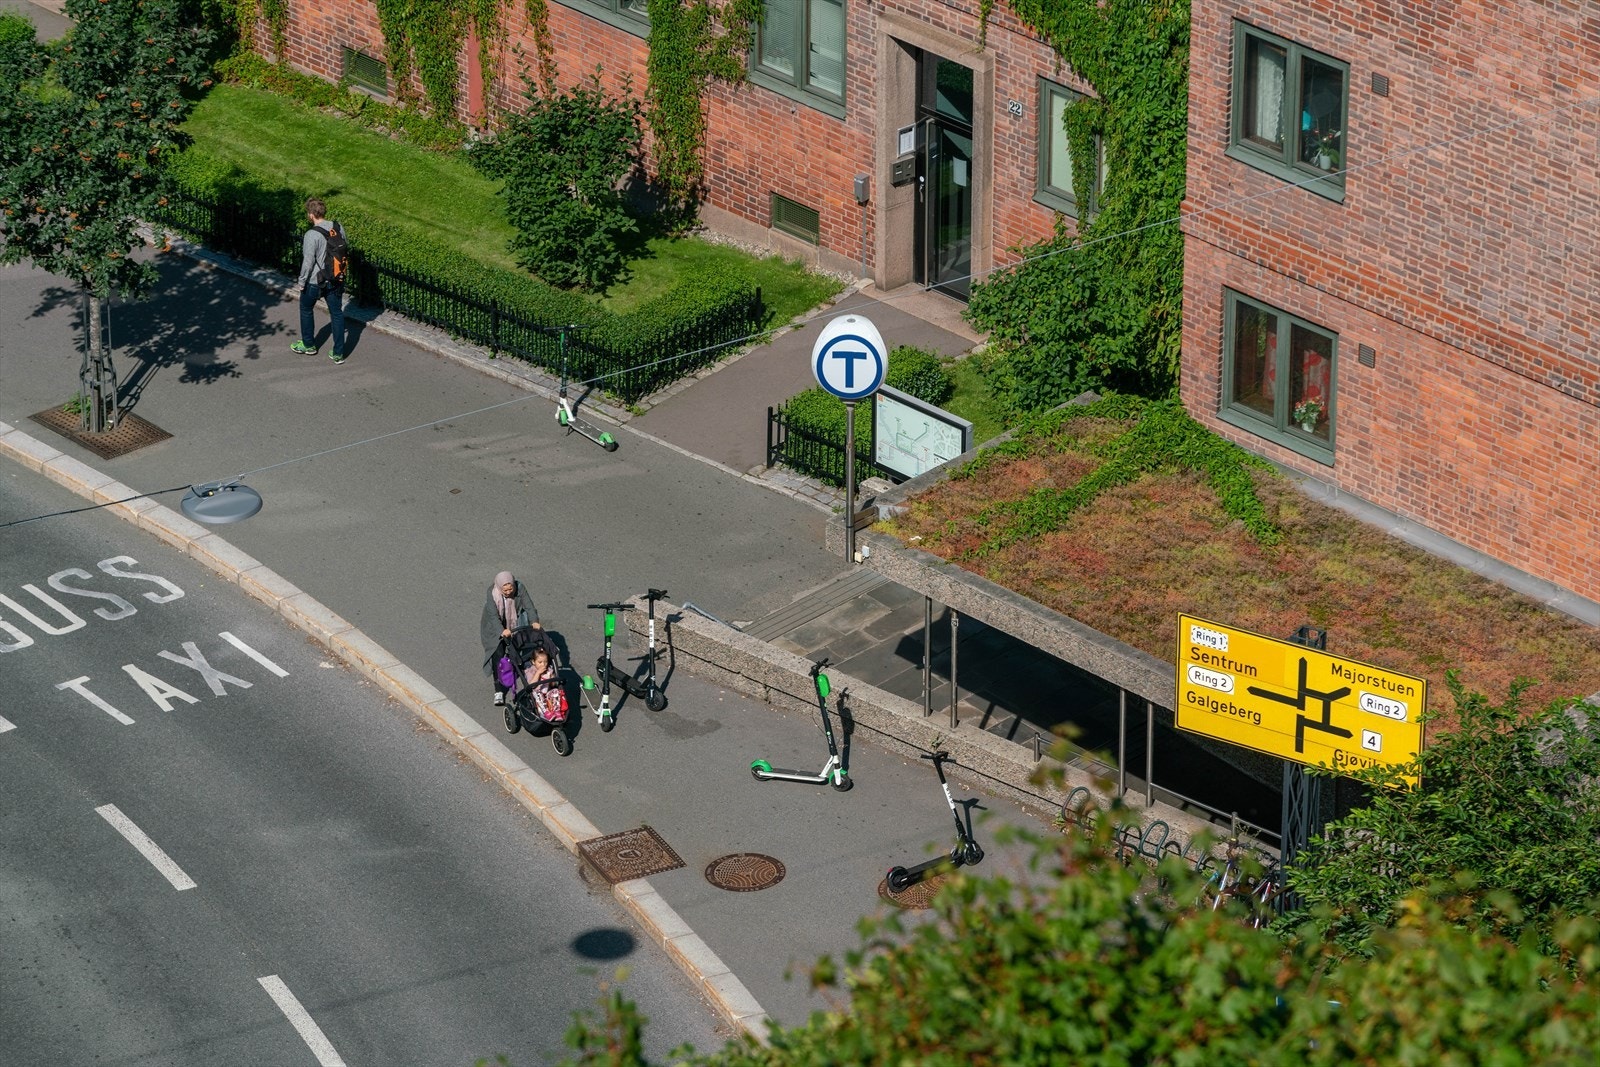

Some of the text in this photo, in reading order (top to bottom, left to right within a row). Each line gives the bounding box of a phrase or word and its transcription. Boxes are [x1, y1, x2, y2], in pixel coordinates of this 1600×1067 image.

[1009, 100, 1022, 115] 22
[832, 351, 867, 388] T
[1196, 630, 1217, 645] Ring
[1190, 646, 1258, 677] Sentrum
[55, 631, 290, 726] TAXI
[1194, 670, 1227, 688] Ring 2
[1331, 662, 1415, 697] Majorstuen
[1186, 690, 1262, 725] Galgeberg
[1366, 698, 1400, 716] Ring 2
[1367, 735, 1376, 747] 4
